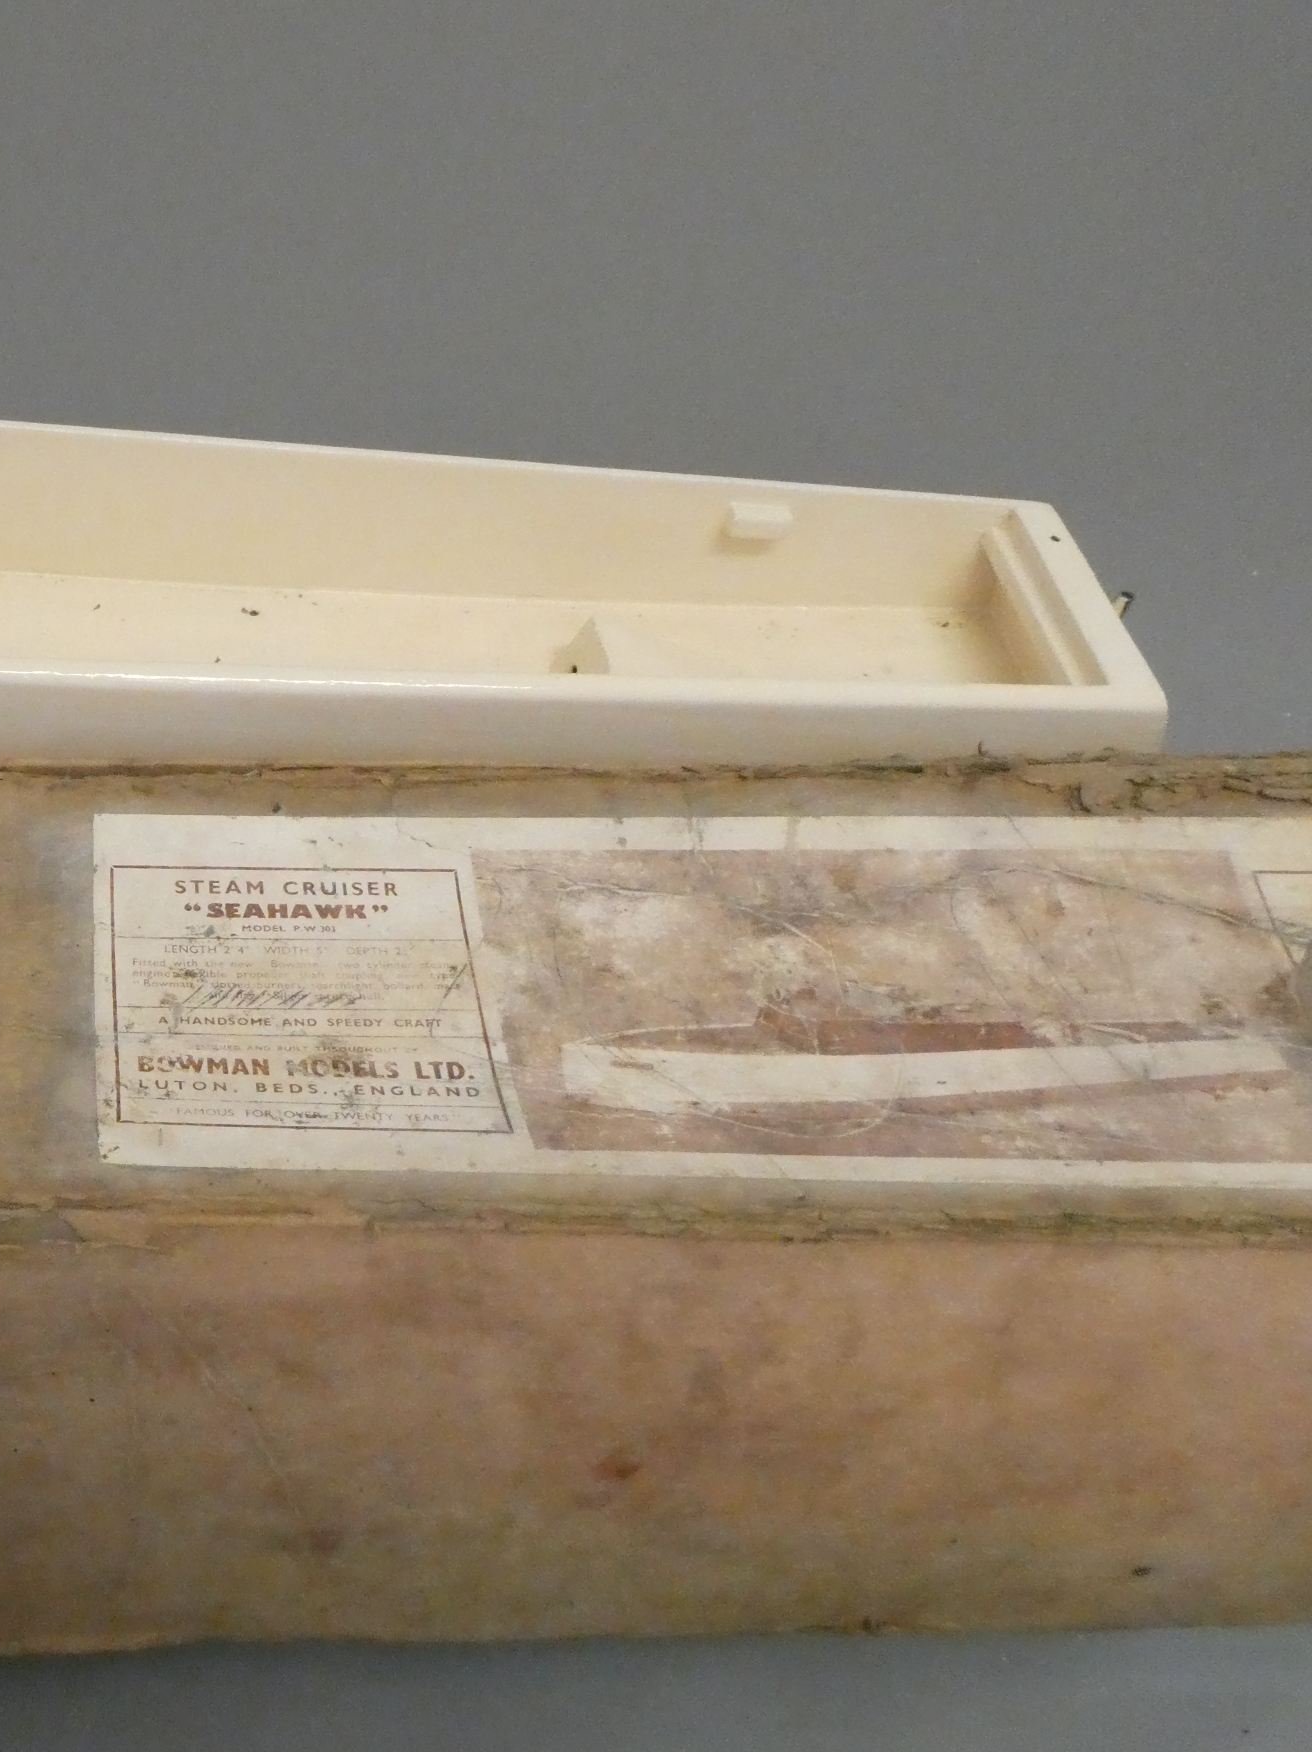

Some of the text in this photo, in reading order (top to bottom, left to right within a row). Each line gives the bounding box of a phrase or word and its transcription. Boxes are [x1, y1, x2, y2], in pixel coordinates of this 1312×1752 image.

[174, 880, 399, 896] STEAM CRUISER
[184, 903, 388, 919] “SEAHAWK”
[241, 924, 286, 933] MODEL
[164, 944, 217, 954] LENGTH
[264, 946, 308, 955] WIDTH
[346, 946, 388, 955] DEPTH
[132, 958, 166, 967] Fitted
[174, 959, 198, 967] with
[158, 1016, 442, 1027] A HANDSOME AND SPEEDY CRAFT
[137, 1055, 475, 1080] BOWMAN MODELS LTD.
[354, 1084, 480, 1097] ENGLAND
[245, 1109, 273, 1118] FOR
[334, 1111, 393, 1121] TWENTY
